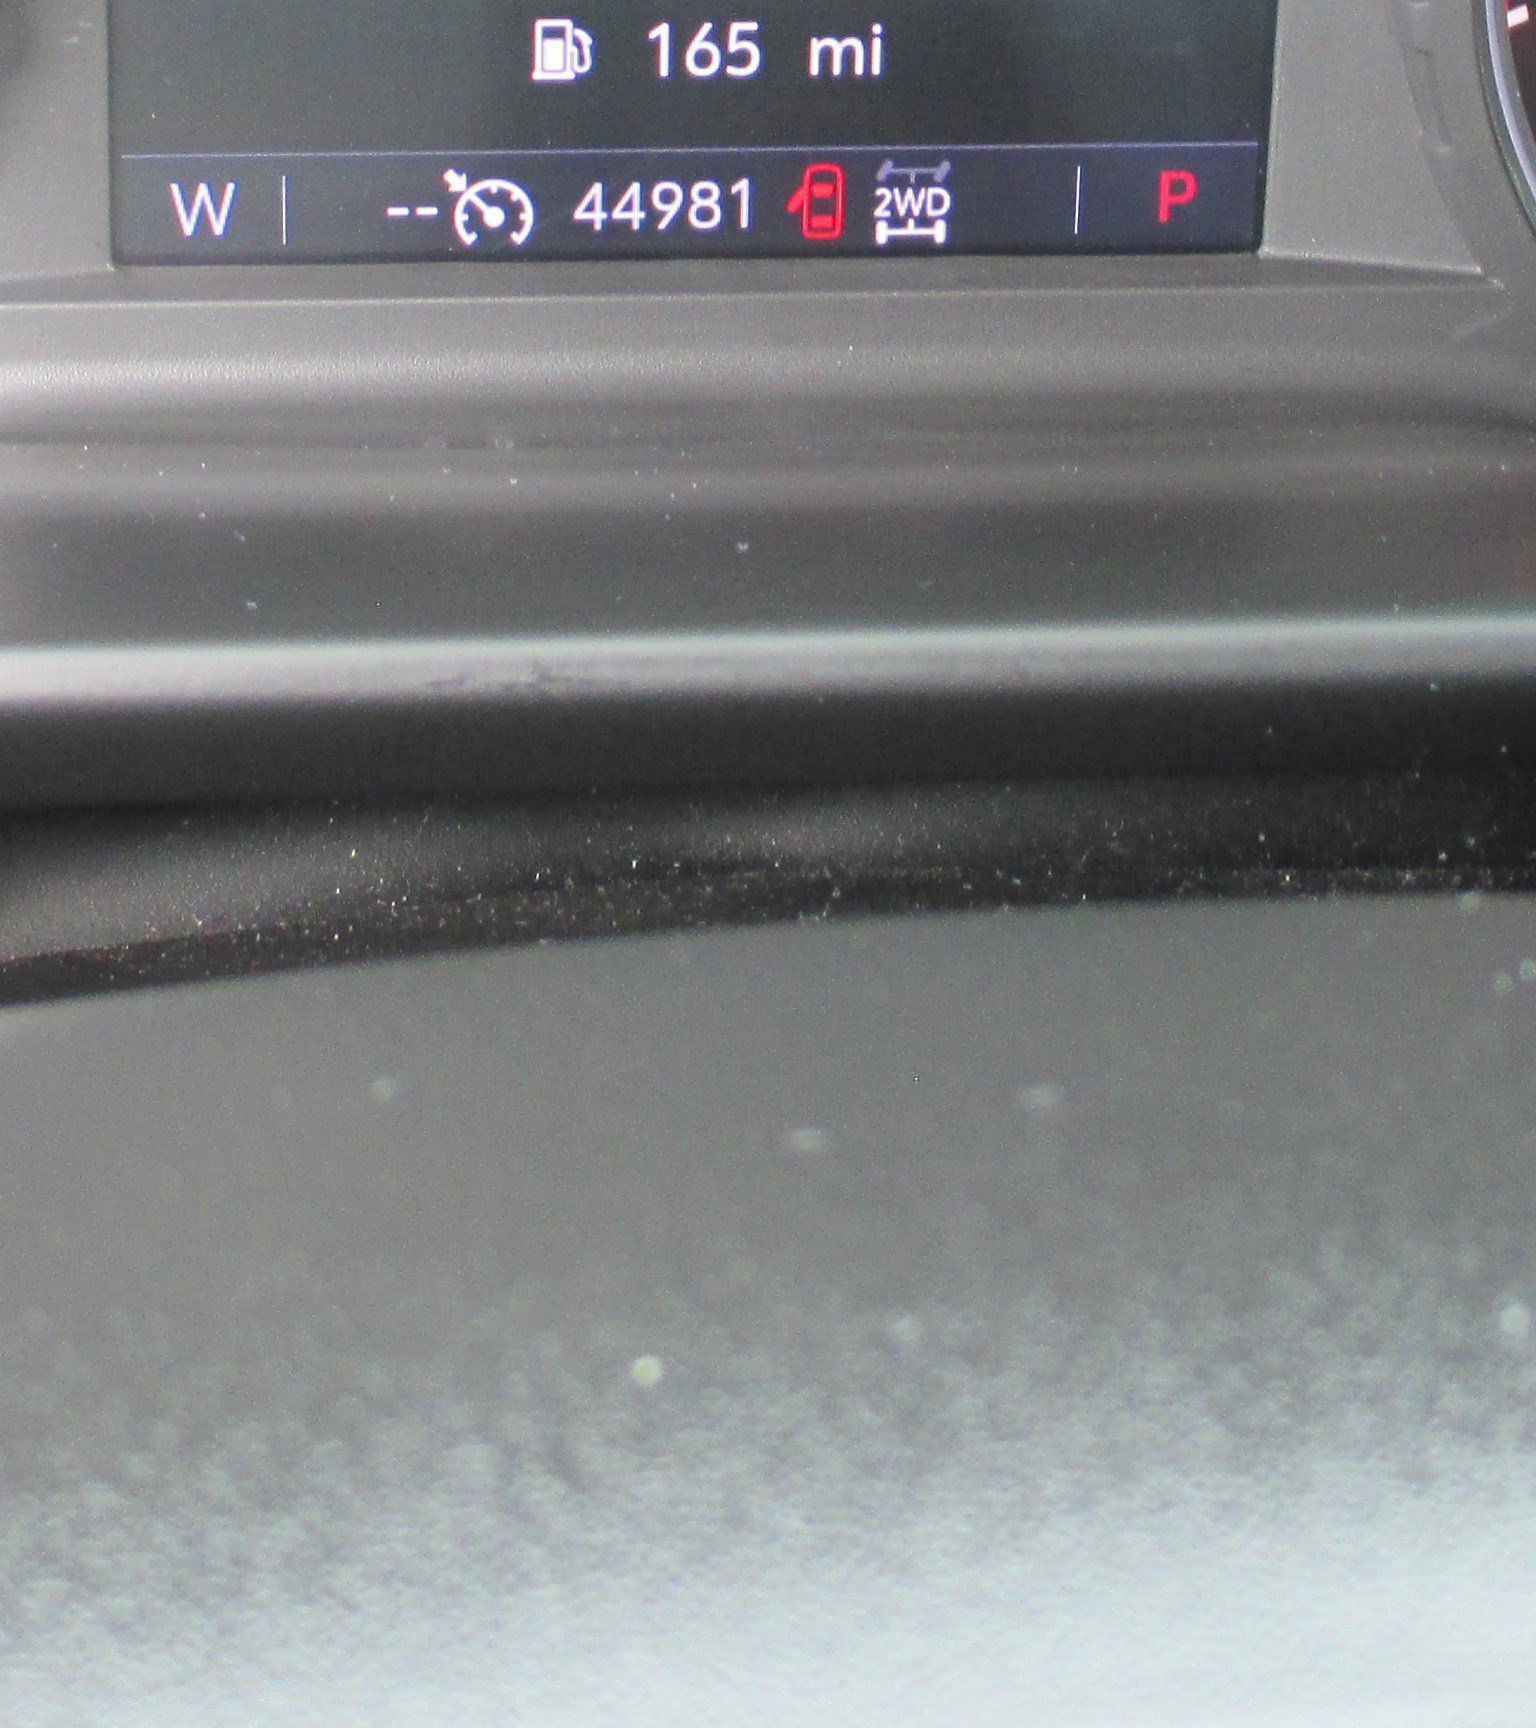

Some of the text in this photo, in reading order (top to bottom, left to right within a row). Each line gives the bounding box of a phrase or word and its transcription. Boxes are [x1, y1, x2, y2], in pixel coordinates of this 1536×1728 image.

[649, 22, 882, 78] 165 mi
[170, 182, 236, 236] W
[574, 178, 752, 230] 44981
[874, 187, 950, 218] 2WD
[1159, 171, 1197, 221] P
